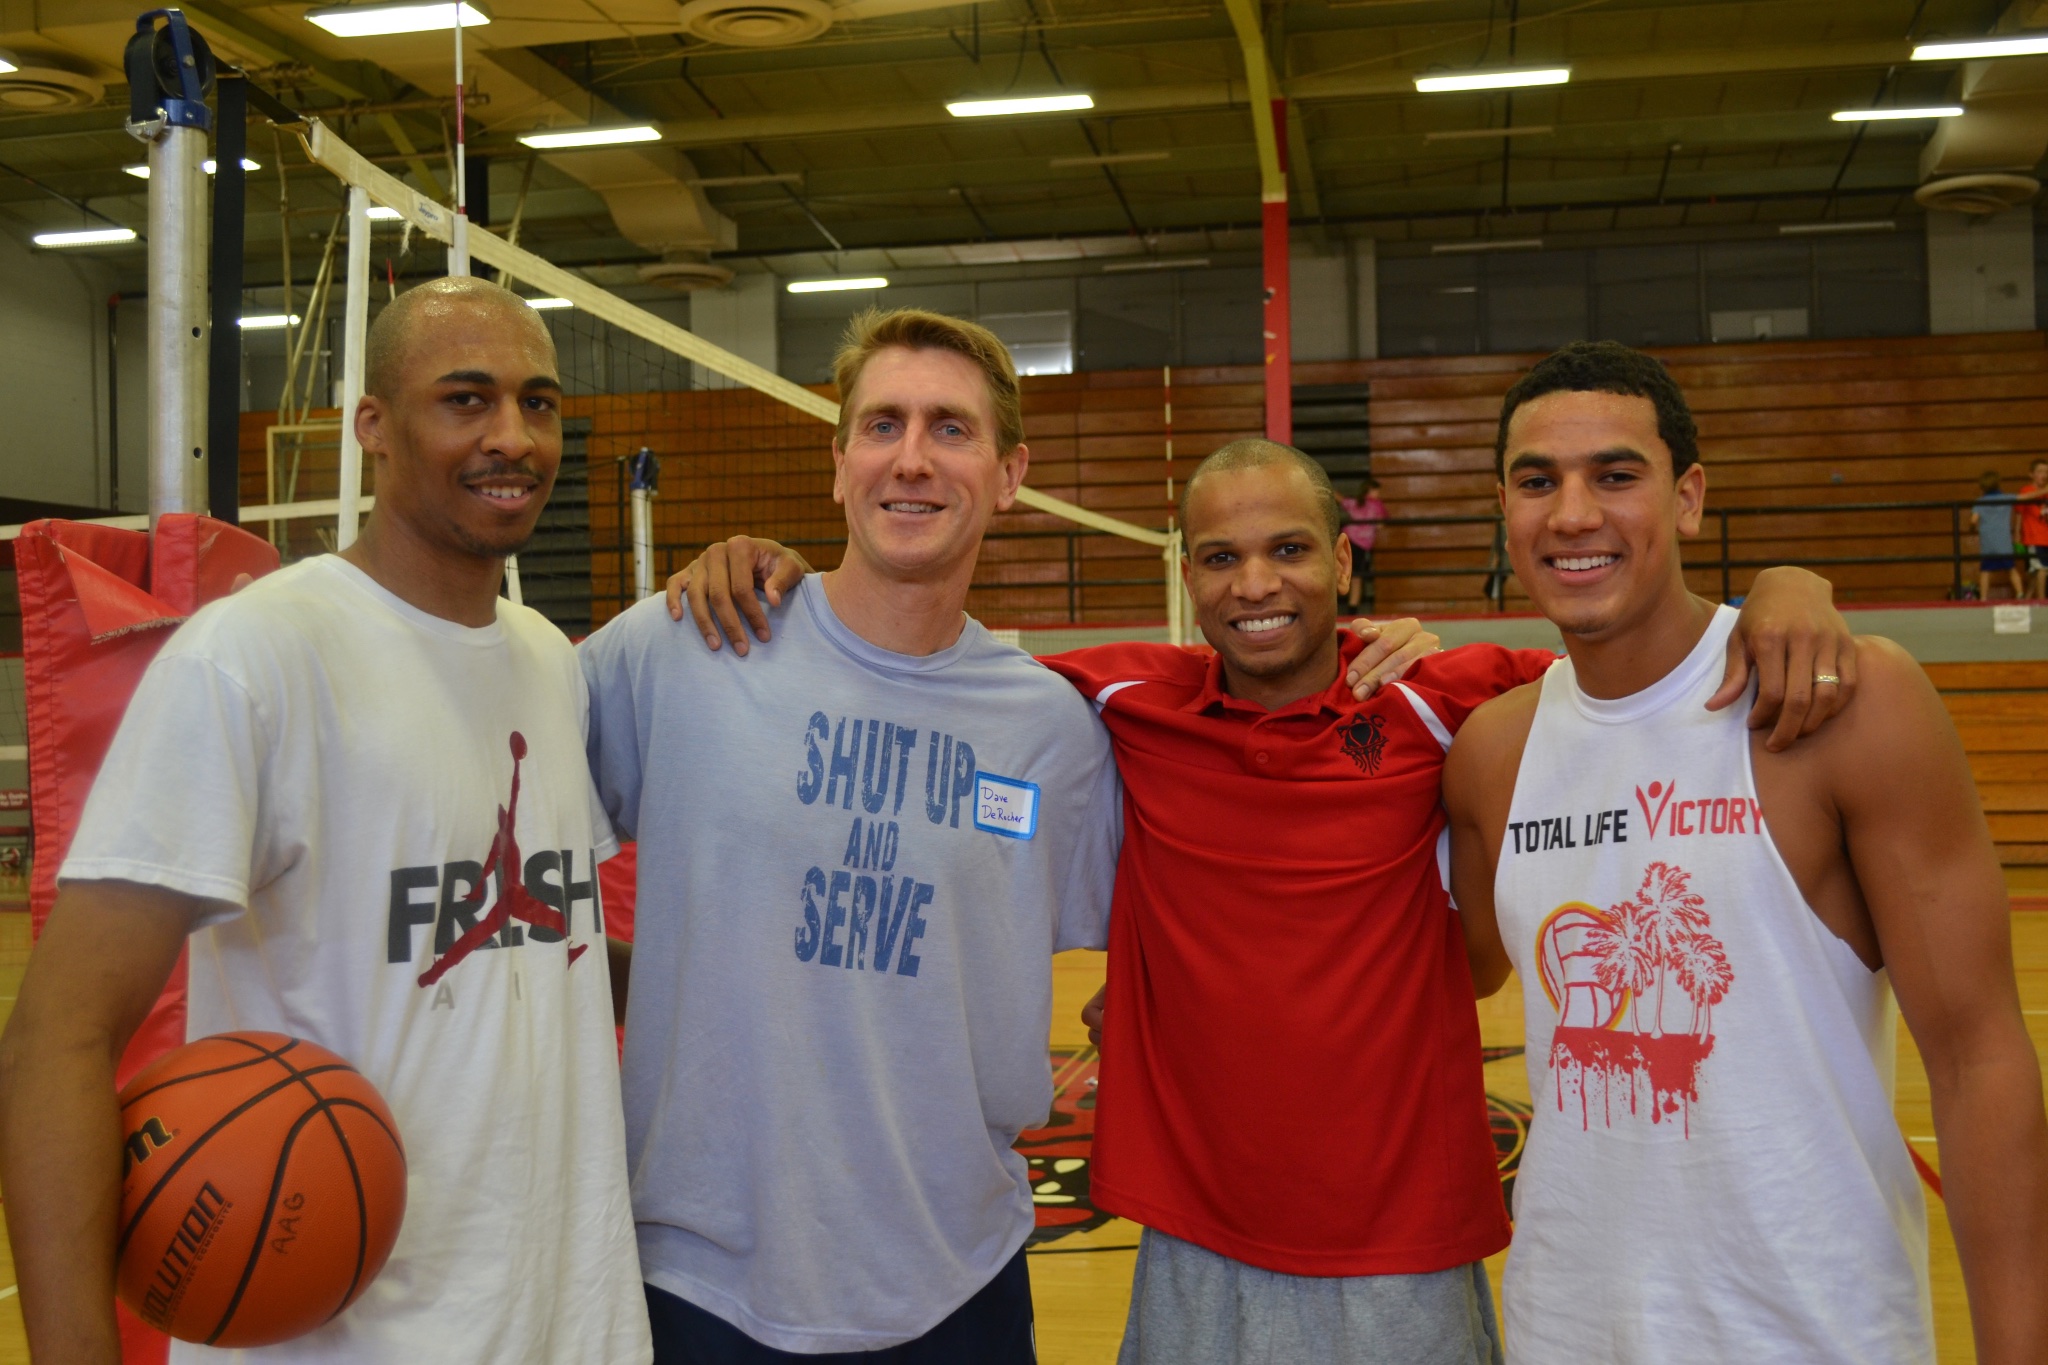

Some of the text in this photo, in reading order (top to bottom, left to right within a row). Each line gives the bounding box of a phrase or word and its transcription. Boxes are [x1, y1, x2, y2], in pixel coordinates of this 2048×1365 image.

[796, 710, 977, 829] SHUT UP
[980, 786, 1008, 803] Dave
[842, 816, 900, 872] AND
[1508, 778, 1764, 854] TOTAL LIFE VICTORY
[794, 865, 935, 978] SERVE
[270, 1192, 306, 1255] AAG
